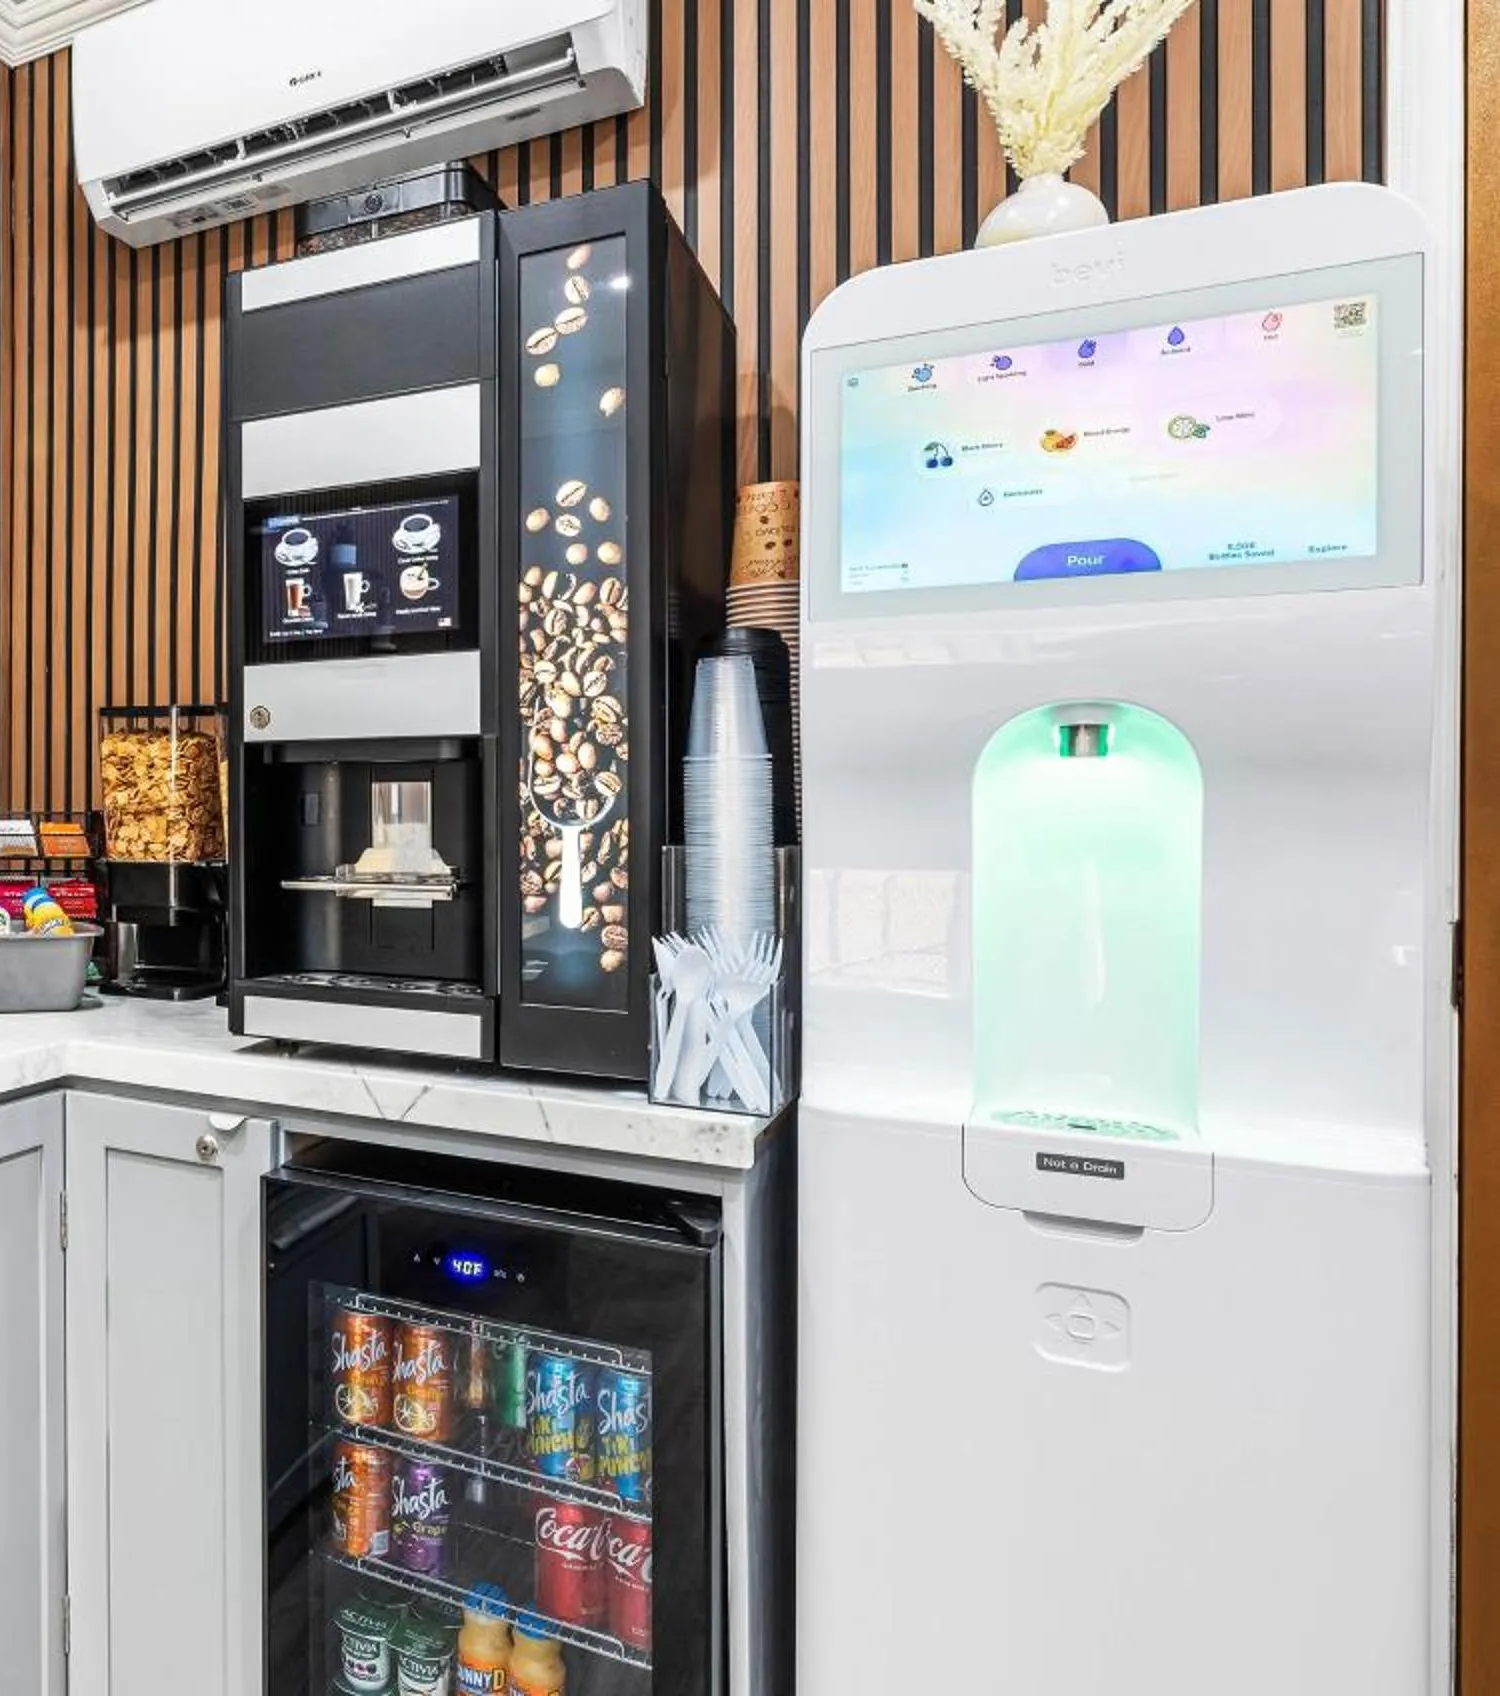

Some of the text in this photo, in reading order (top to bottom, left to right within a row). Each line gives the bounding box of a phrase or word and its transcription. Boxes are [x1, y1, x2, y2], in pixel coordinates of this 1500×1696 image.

[1066, 554, 1105, 568] Pour
[1043, 1157, 1118, 1175] Not a Drain
[331, 1328, 387, 1373] Shasta
[527, 1370, 590, 1415] Shasta
[598, 1388, 650, 1435] Shas
[392, 1476, 449, 1520] Shasta
